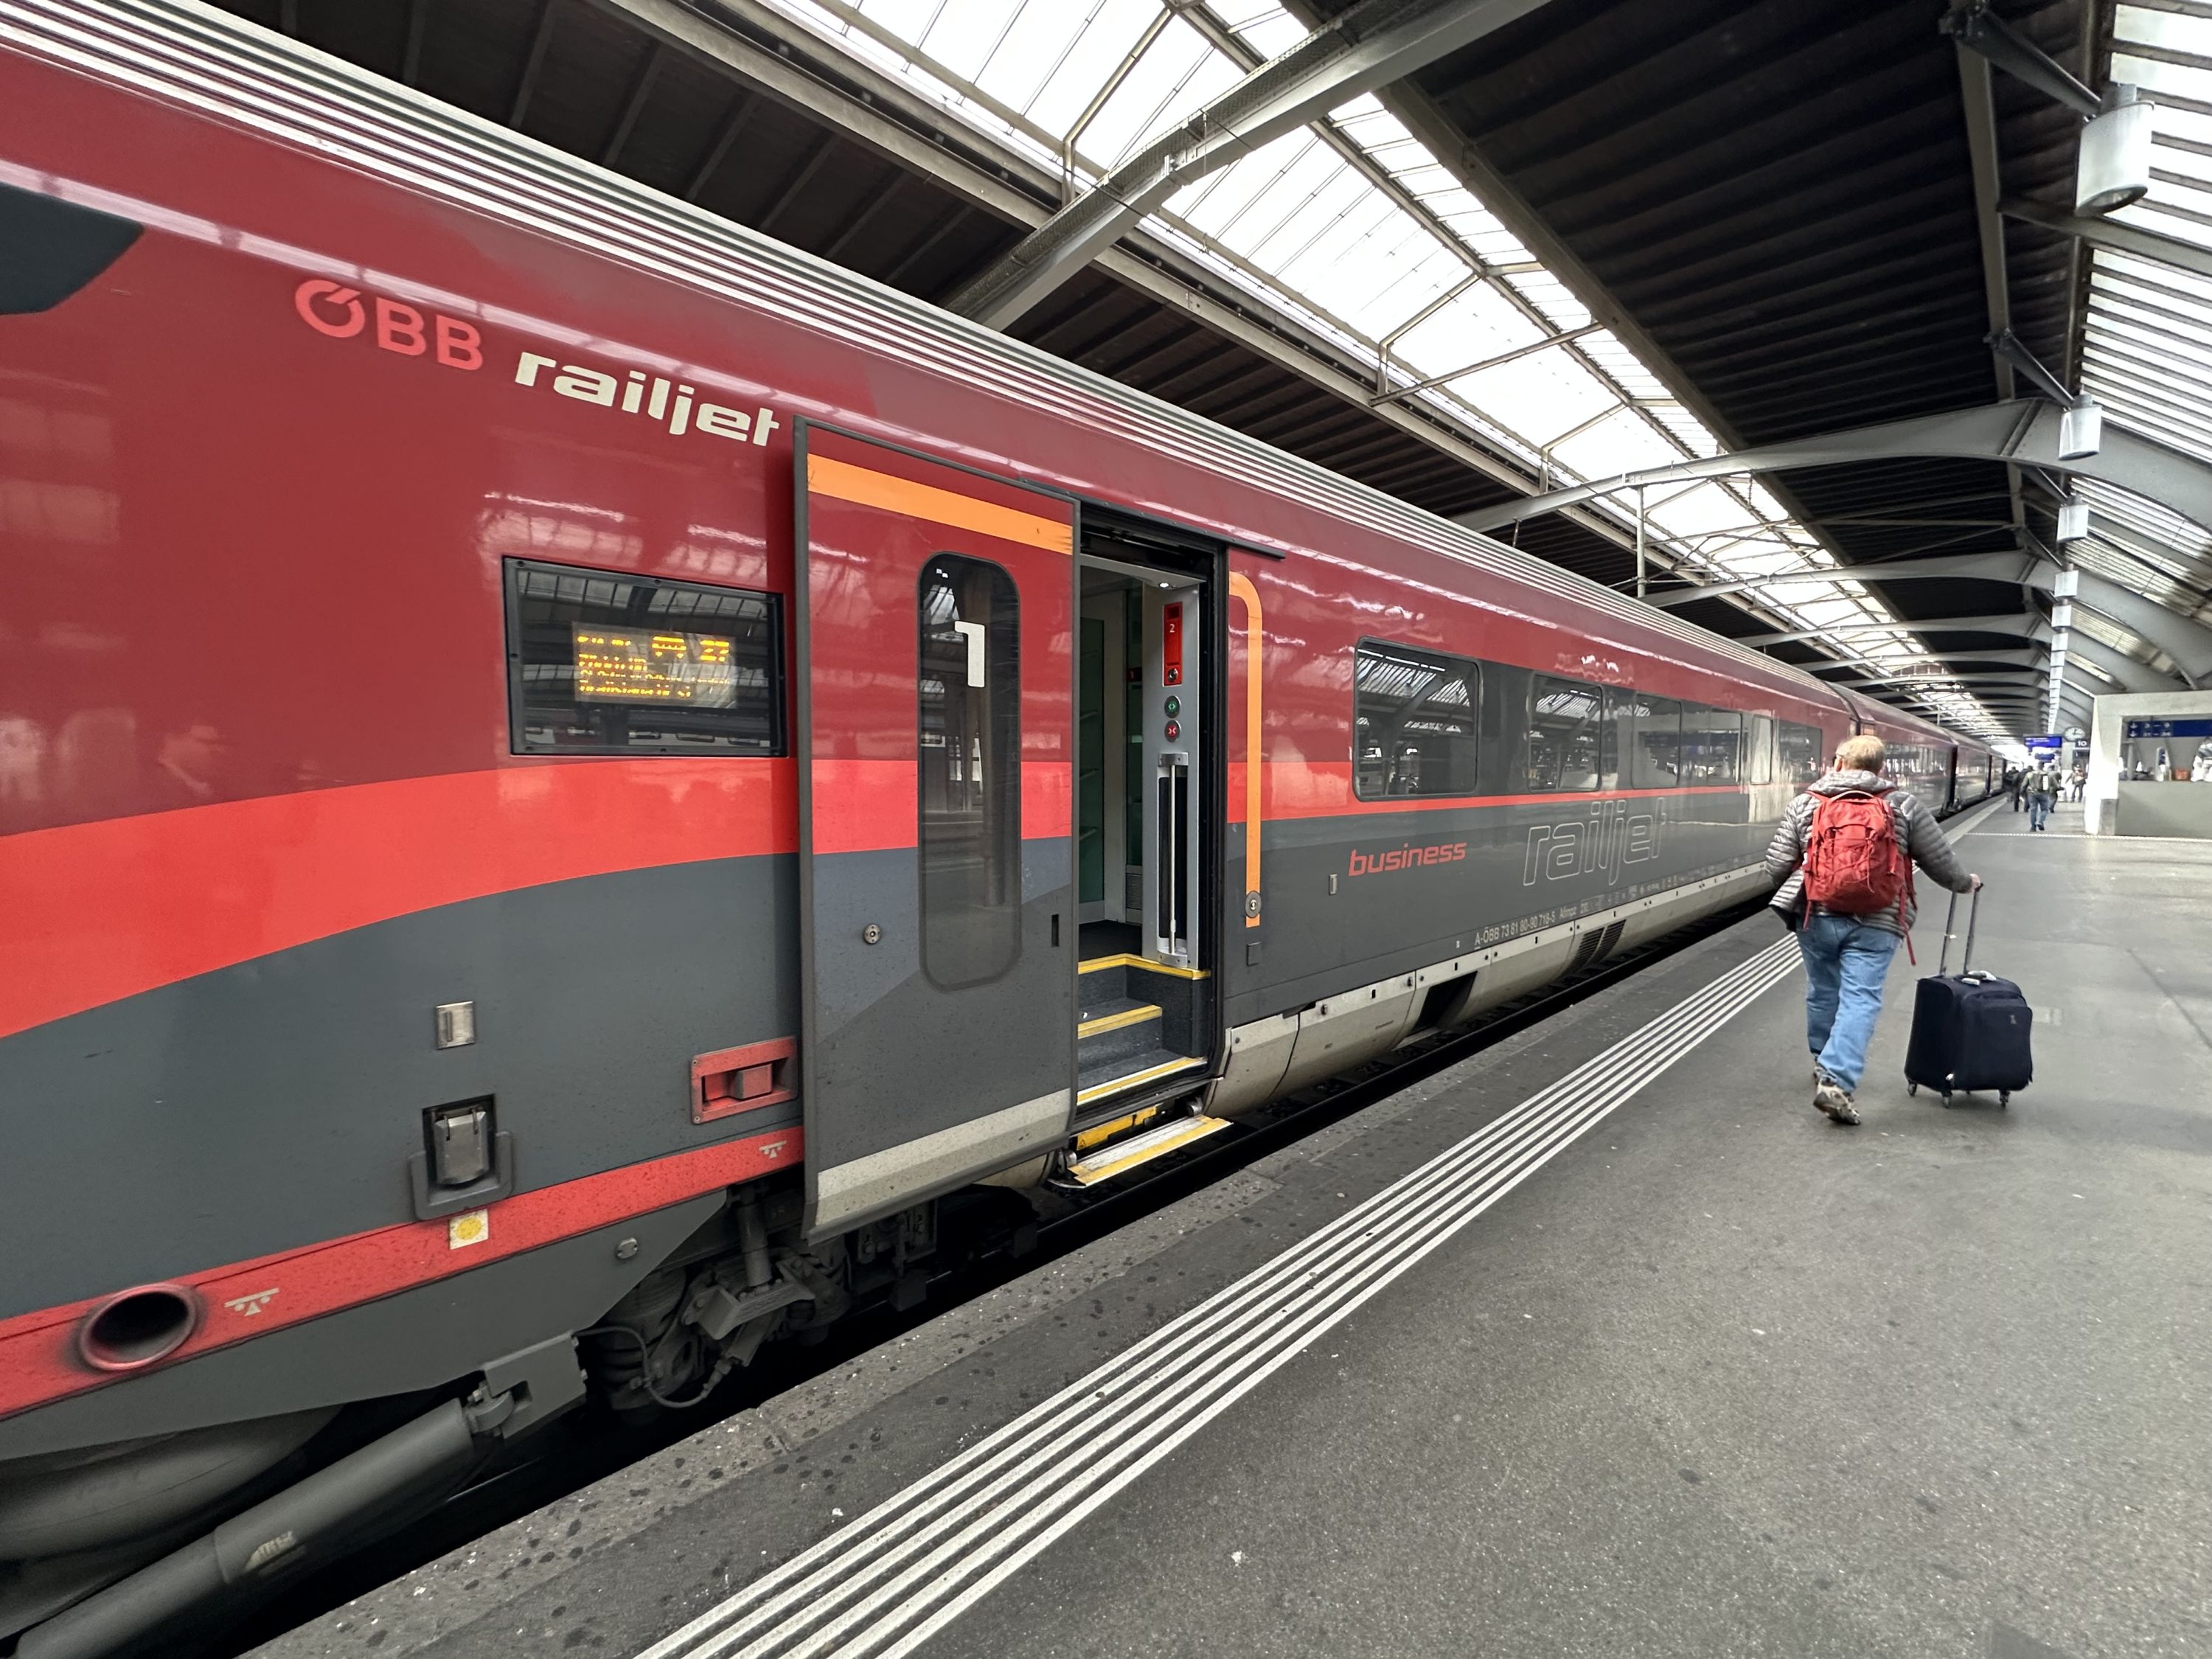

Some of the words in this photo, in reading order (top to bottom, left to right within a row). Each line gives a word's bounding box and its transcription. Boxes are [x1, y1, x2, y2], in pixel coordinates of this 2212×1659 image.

[515, 351, 779, 446] railjet
[1169, 624, 1175, 633] 2
[955, 621, 985, 687] 1
[1349, 843, 1467, 876] business
[1523, 797, 1666, 886] railjet
[1501, 925, 1509, 938] 73
